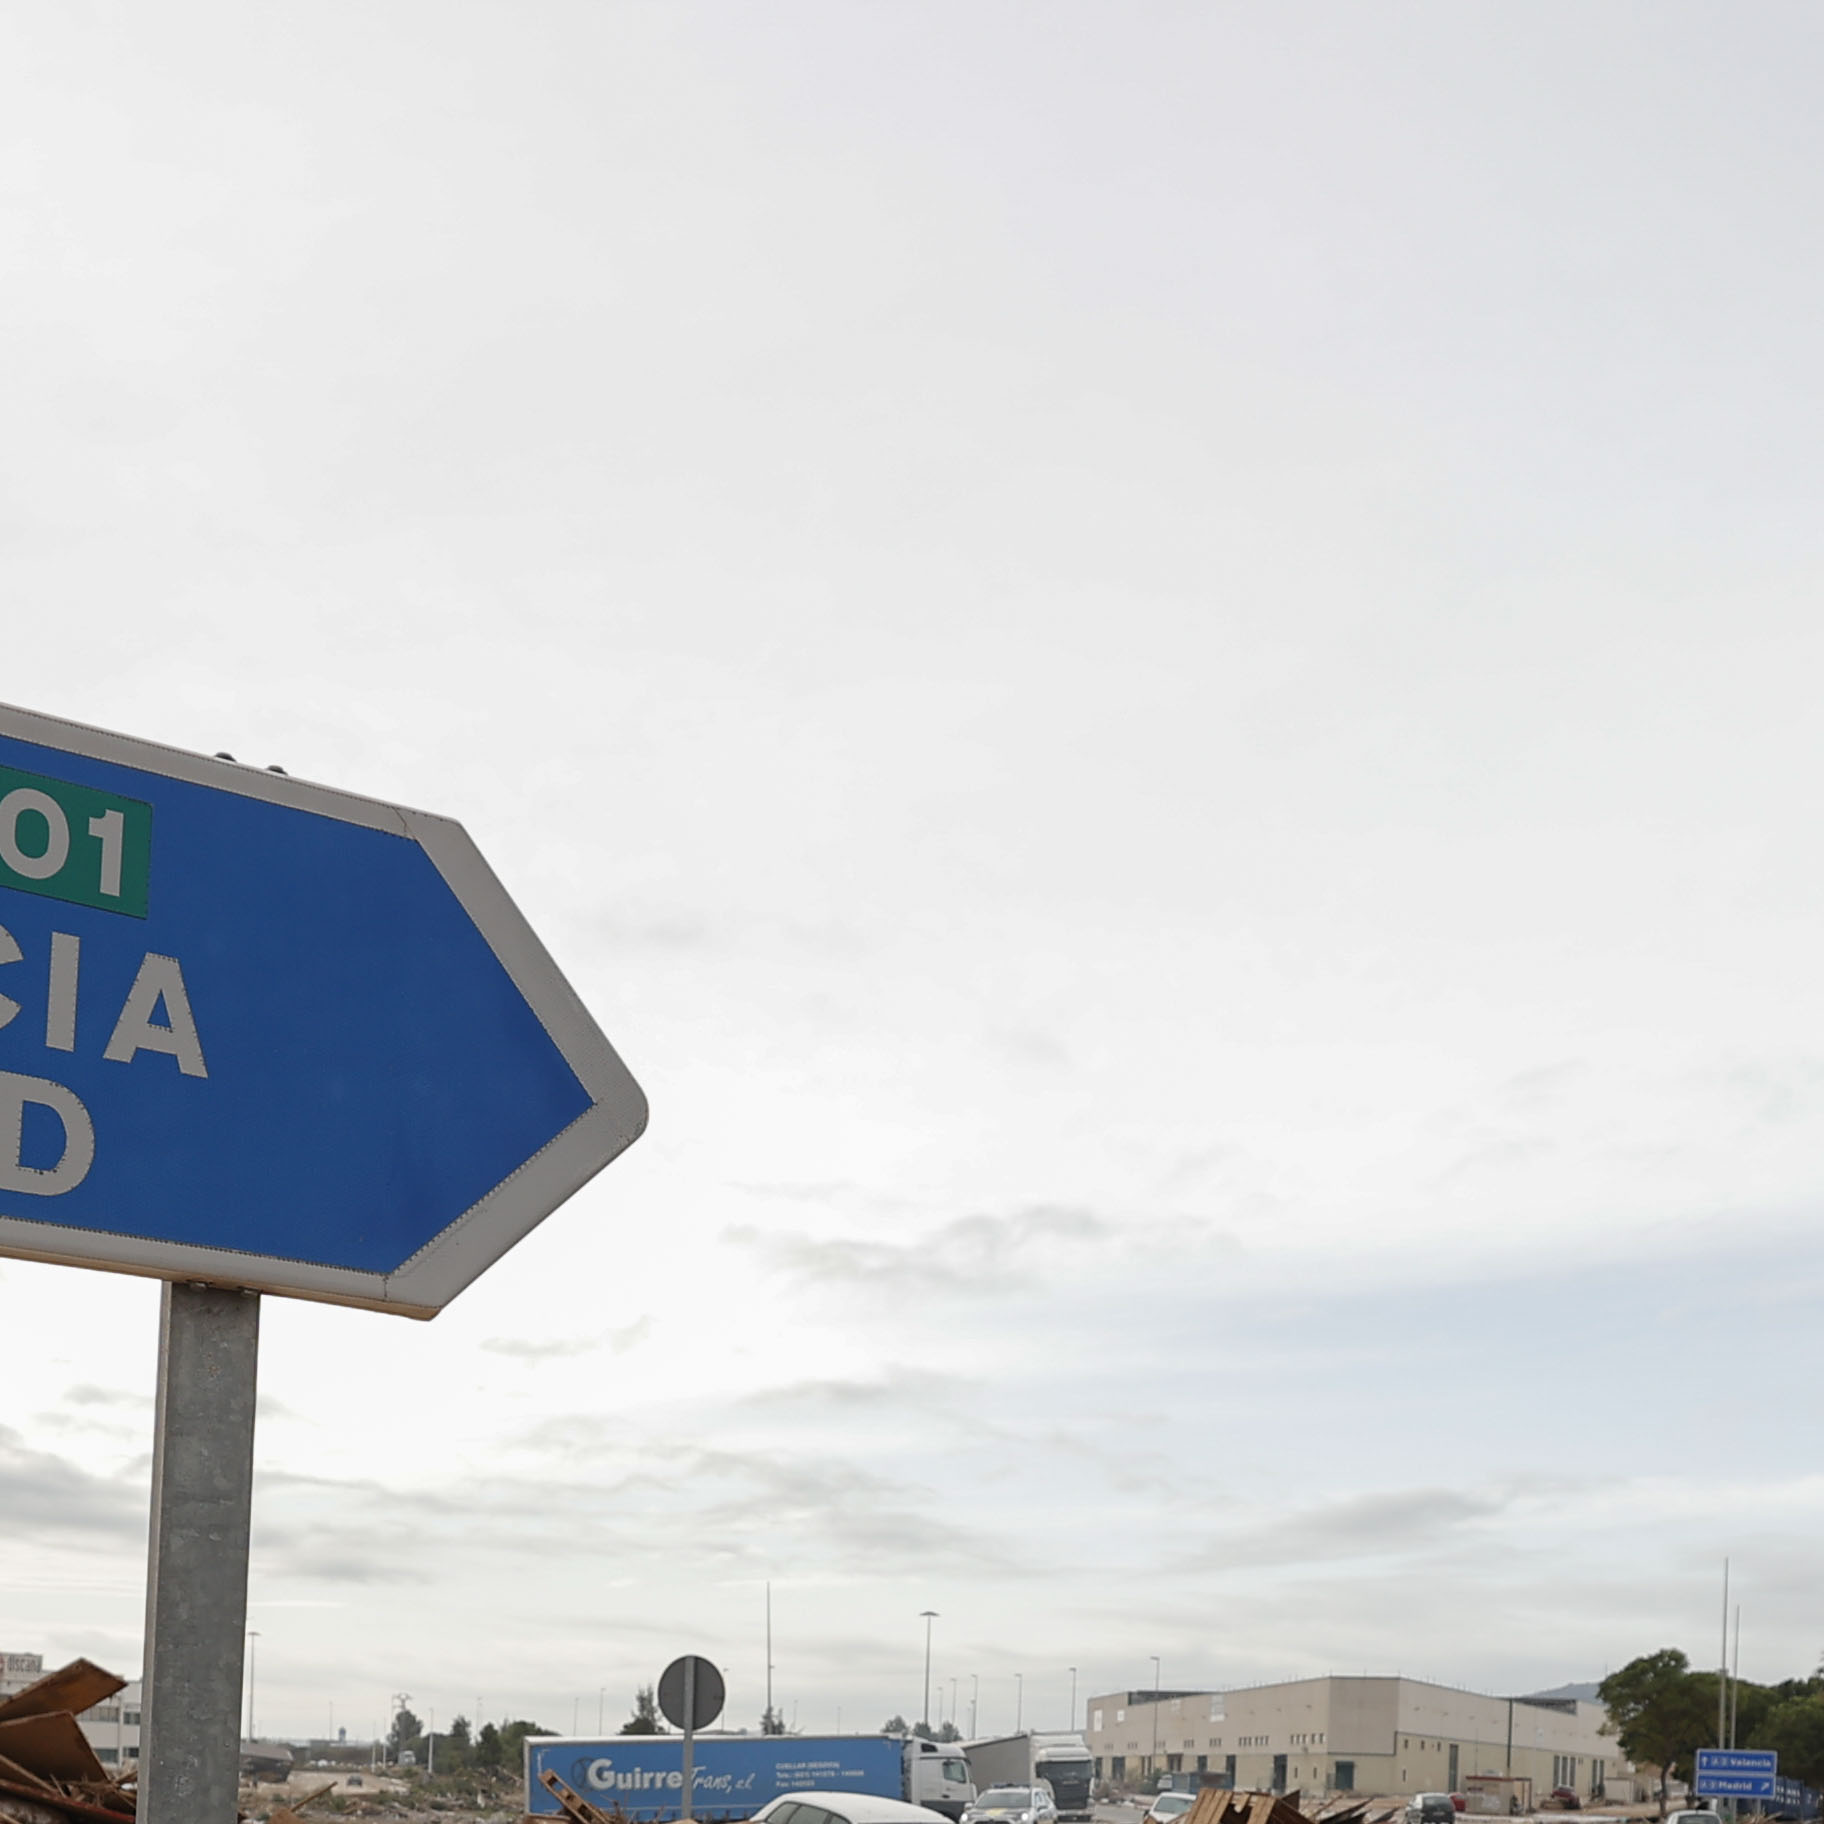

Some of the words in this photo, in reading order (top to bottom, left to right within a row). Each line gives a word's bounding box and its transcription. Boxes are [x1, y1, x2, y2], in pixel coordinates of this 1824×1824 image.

[1730, 1757, 1772, 1768] Valencia
[587, 1757, 683, 1790] Guirre
[1719, 1781, 1753, 1791] Madrid
